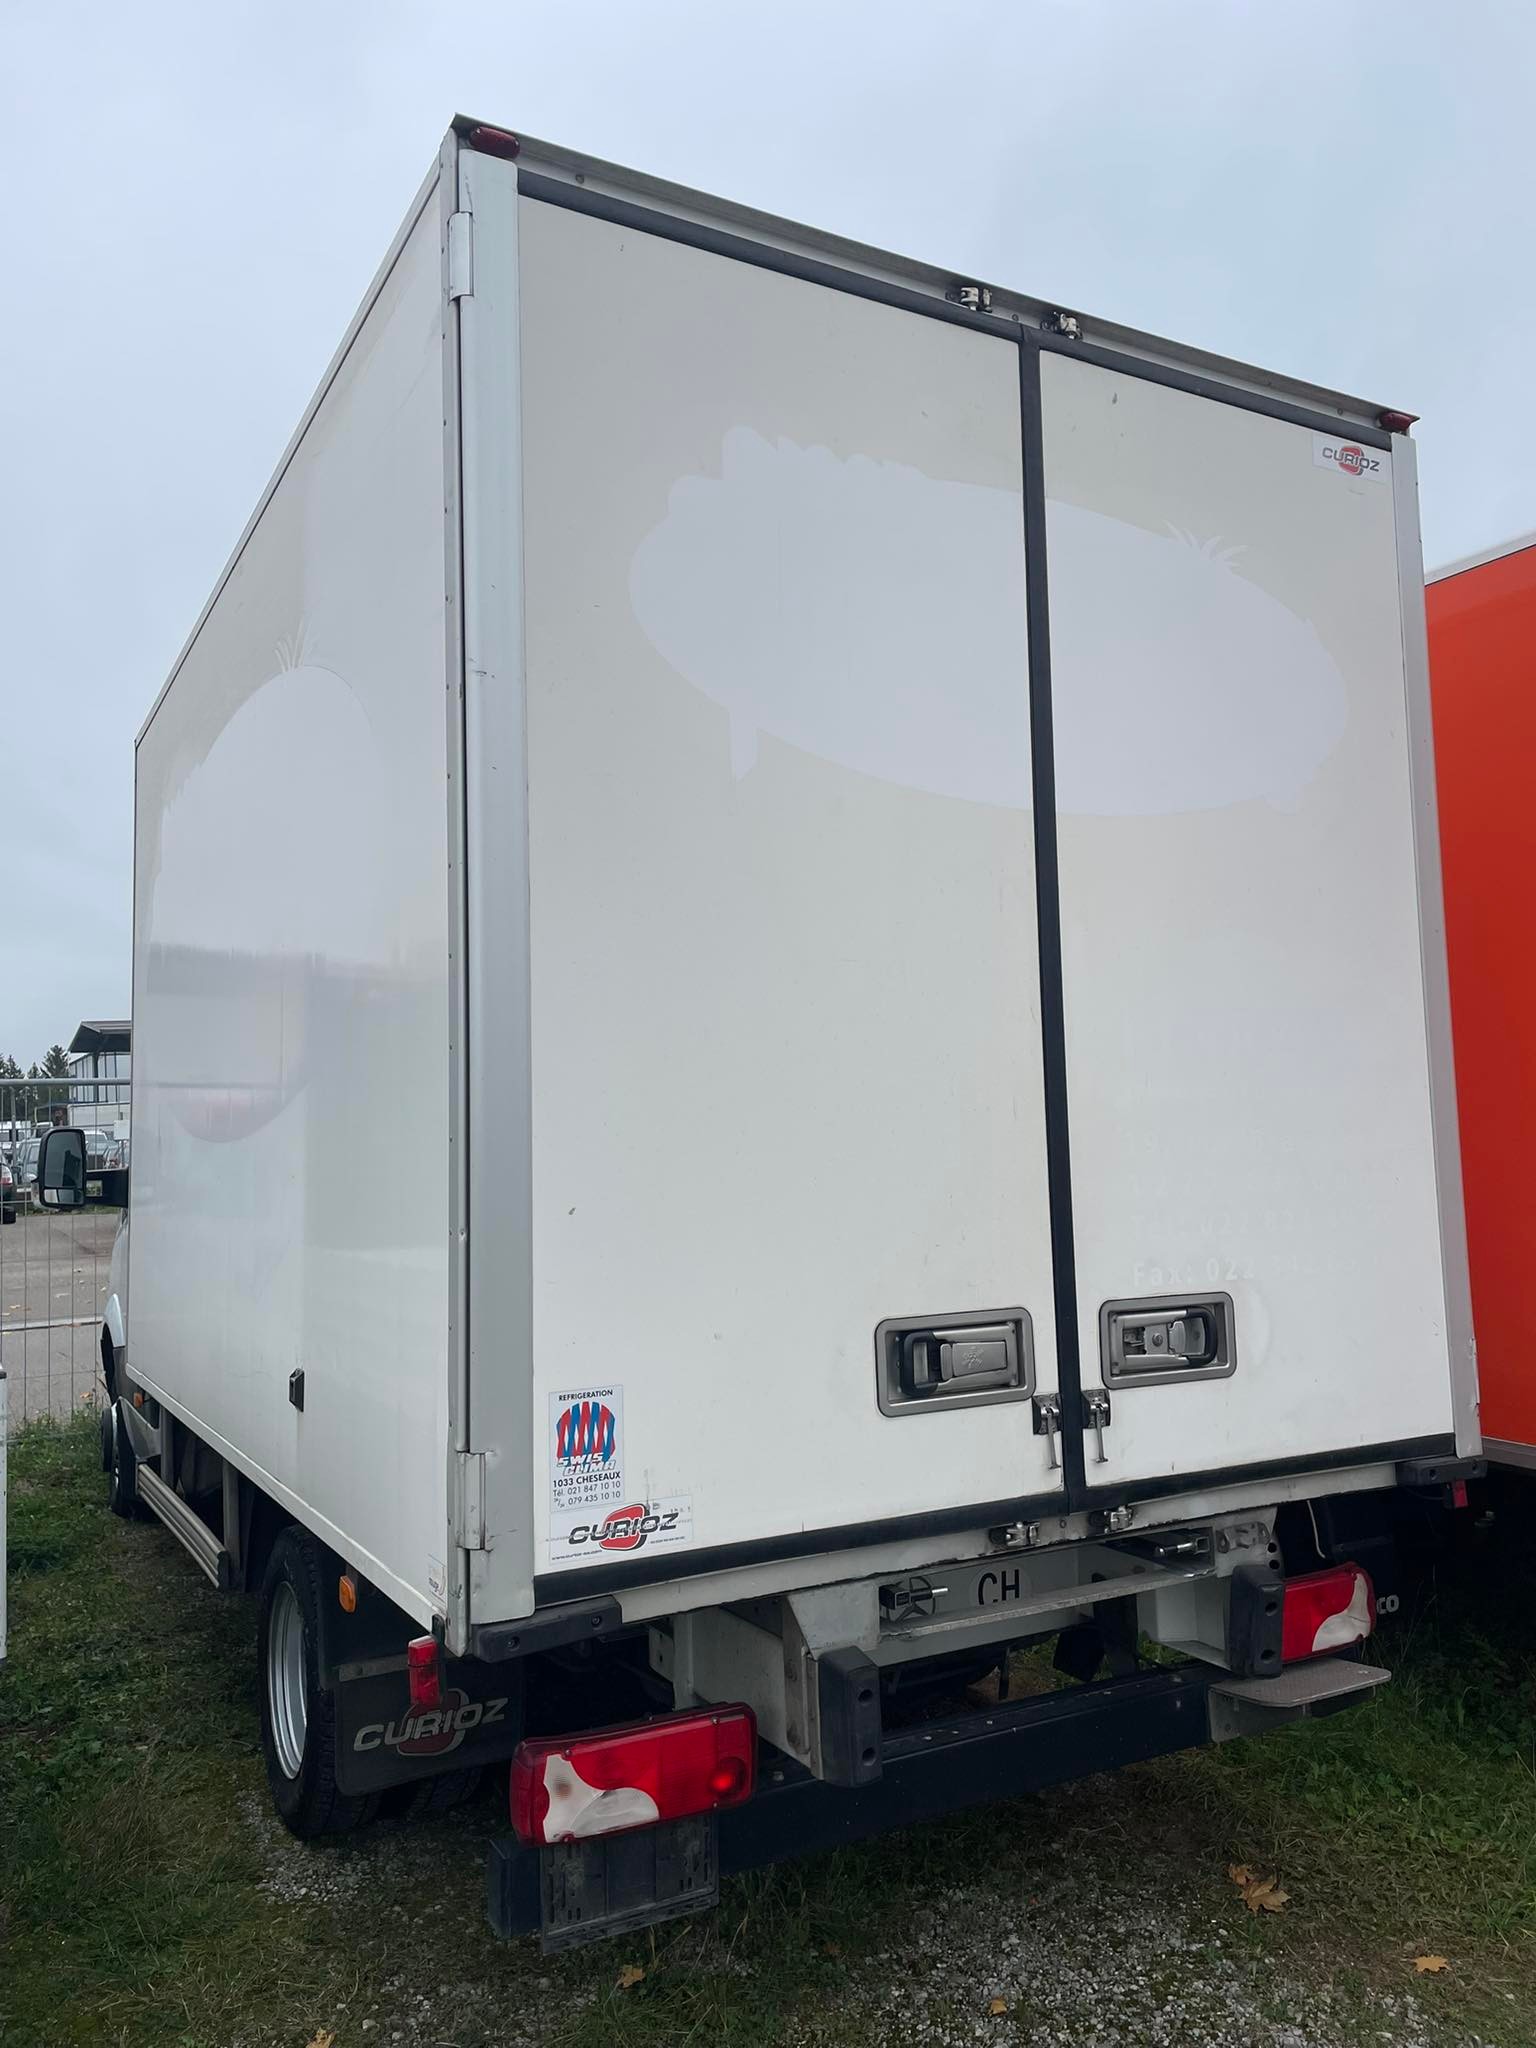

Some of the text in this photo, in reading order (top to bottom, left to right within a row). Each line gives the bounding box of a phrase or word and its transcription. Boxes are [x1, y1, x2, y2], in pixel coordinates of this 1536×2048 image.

[1322, 447, 1380, 472] CURIOZ
[558, 1389, 613, 1401] REFRIGERATION
[553, 1471, 620, 1488] 1033 CHESEAUX
[567, 1486, 581, 1495] 021
[583, 1484, 598, 1493] 847
[600, 1482, 609, 1490] 10
[612, 1480, 621, 1488] 10
[567, 1497, 582, 1505] 079
[584, 1494, 598, 1502] 435
[600, 1492, 609, 1500] 10
[568, 1512, 679, 1545] CURIOZ
[978, 1569, 1020, 1605] CH
[353, 1697, 509, 1751] CURIOZ
